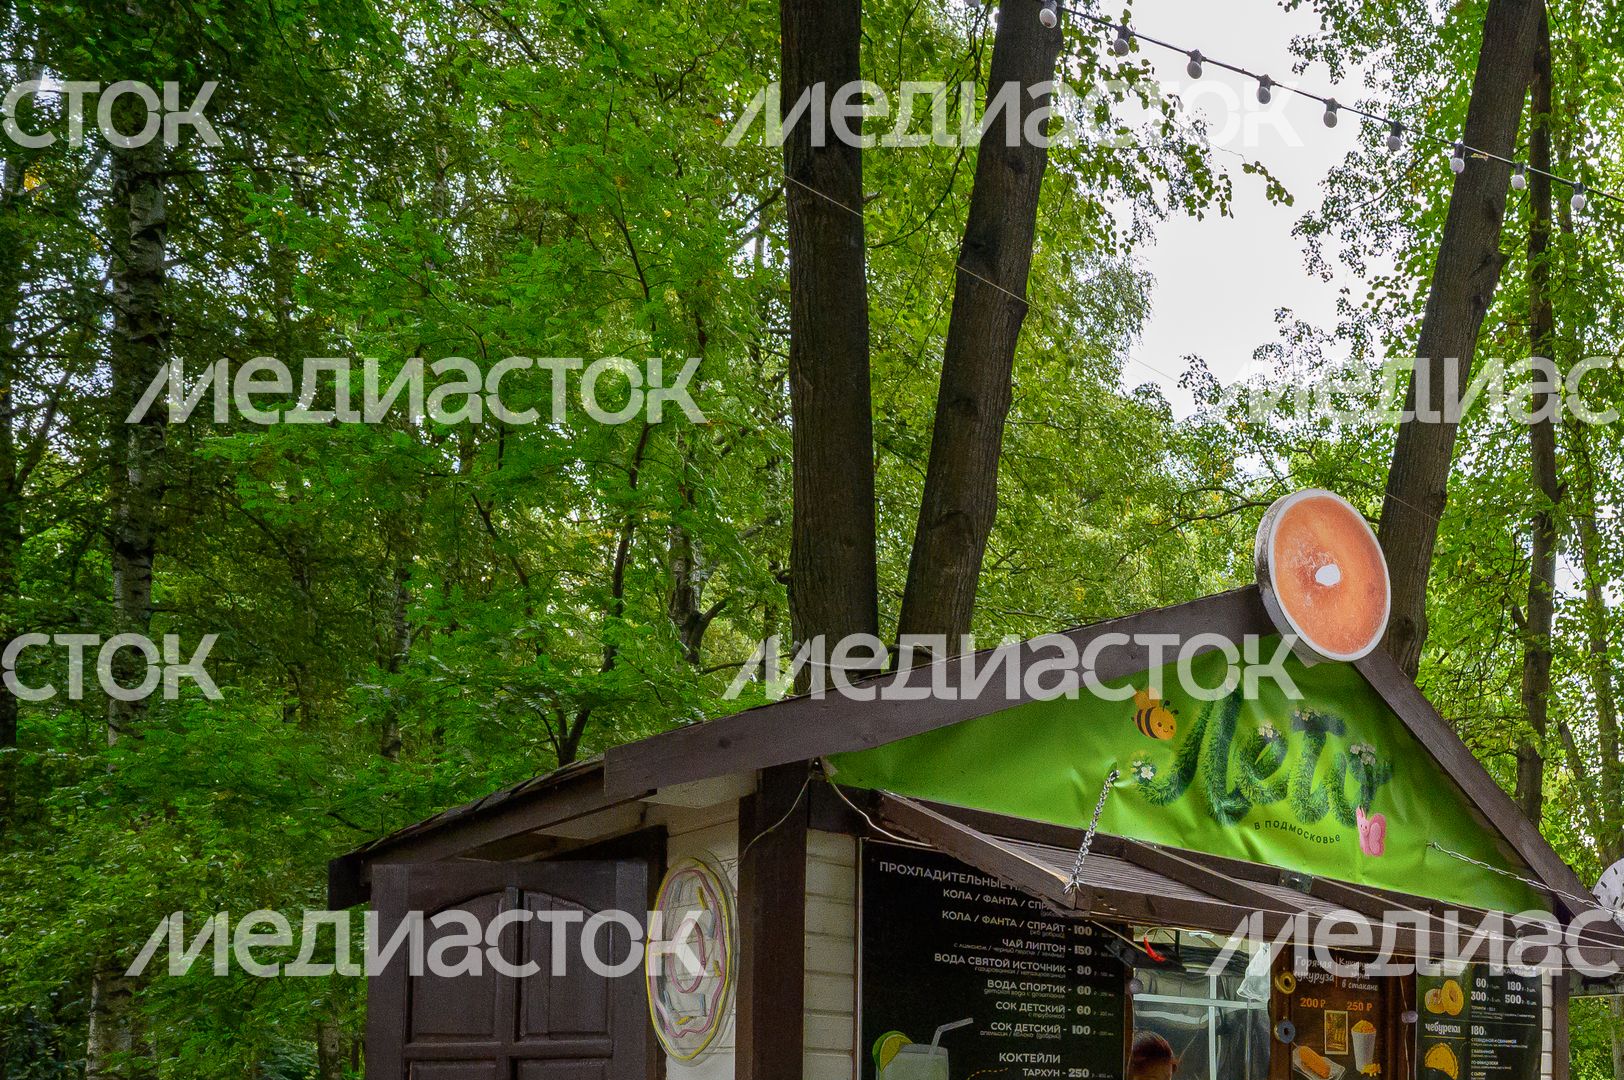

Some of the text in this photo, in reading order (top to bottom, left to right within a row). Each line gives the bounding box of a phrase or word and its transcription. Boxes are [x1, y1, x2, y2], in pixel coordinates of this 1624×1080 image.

[879, 862, 1007, 891] ПРОХЛАДИТЕЛЬНЫЕ
[943, 889, 972, 901] КОЛА
[983, 894, 1018, 907] ФАНТА
[942, 910, 971, 922] КОЛА
[981, 915, 1017, 928] ФАНТА
[1027, 921, 1065, 933] СПРАЙТ
[1073, 925, 1092, 935] 100
[1002, 938, 1023, 949] ЧАЙ
[1026, 941, 1065, 953] ЛИПТОН
[1074, 945, 1092, 956] 150
[934, 953, 1092, 976] ВОДА СВЯТОЙ ИСТОЧНИК 80
[988, 979, 1017, 991] ВОДА
[1019, 982, 1066, 993] СПОРТИК
[1077, 986, 1092, 995] 60
[1476, 978, 1486, 988] 60
[1508, 981, 1521, 991] 180
[1471, 992, 1486, 1001] 300
[1505, 995, 1522, 1005] 500
[996, 1001, 1091, 1015] СОК ДЕТСКИЙ 60
[1300, 998, 1318, 1008] 200
[1347, 1002, 1364, 1011] 250
[991, 1022, 1090, 1035] СОК ДЕТСКИЙ 100
[1471, 1026, 1484, 1035] 180
[999, 1052, 1060, 1063] КОКТЕЙЛИ
[1023, 1068, 1089, 1078] ТАРХУН 250
